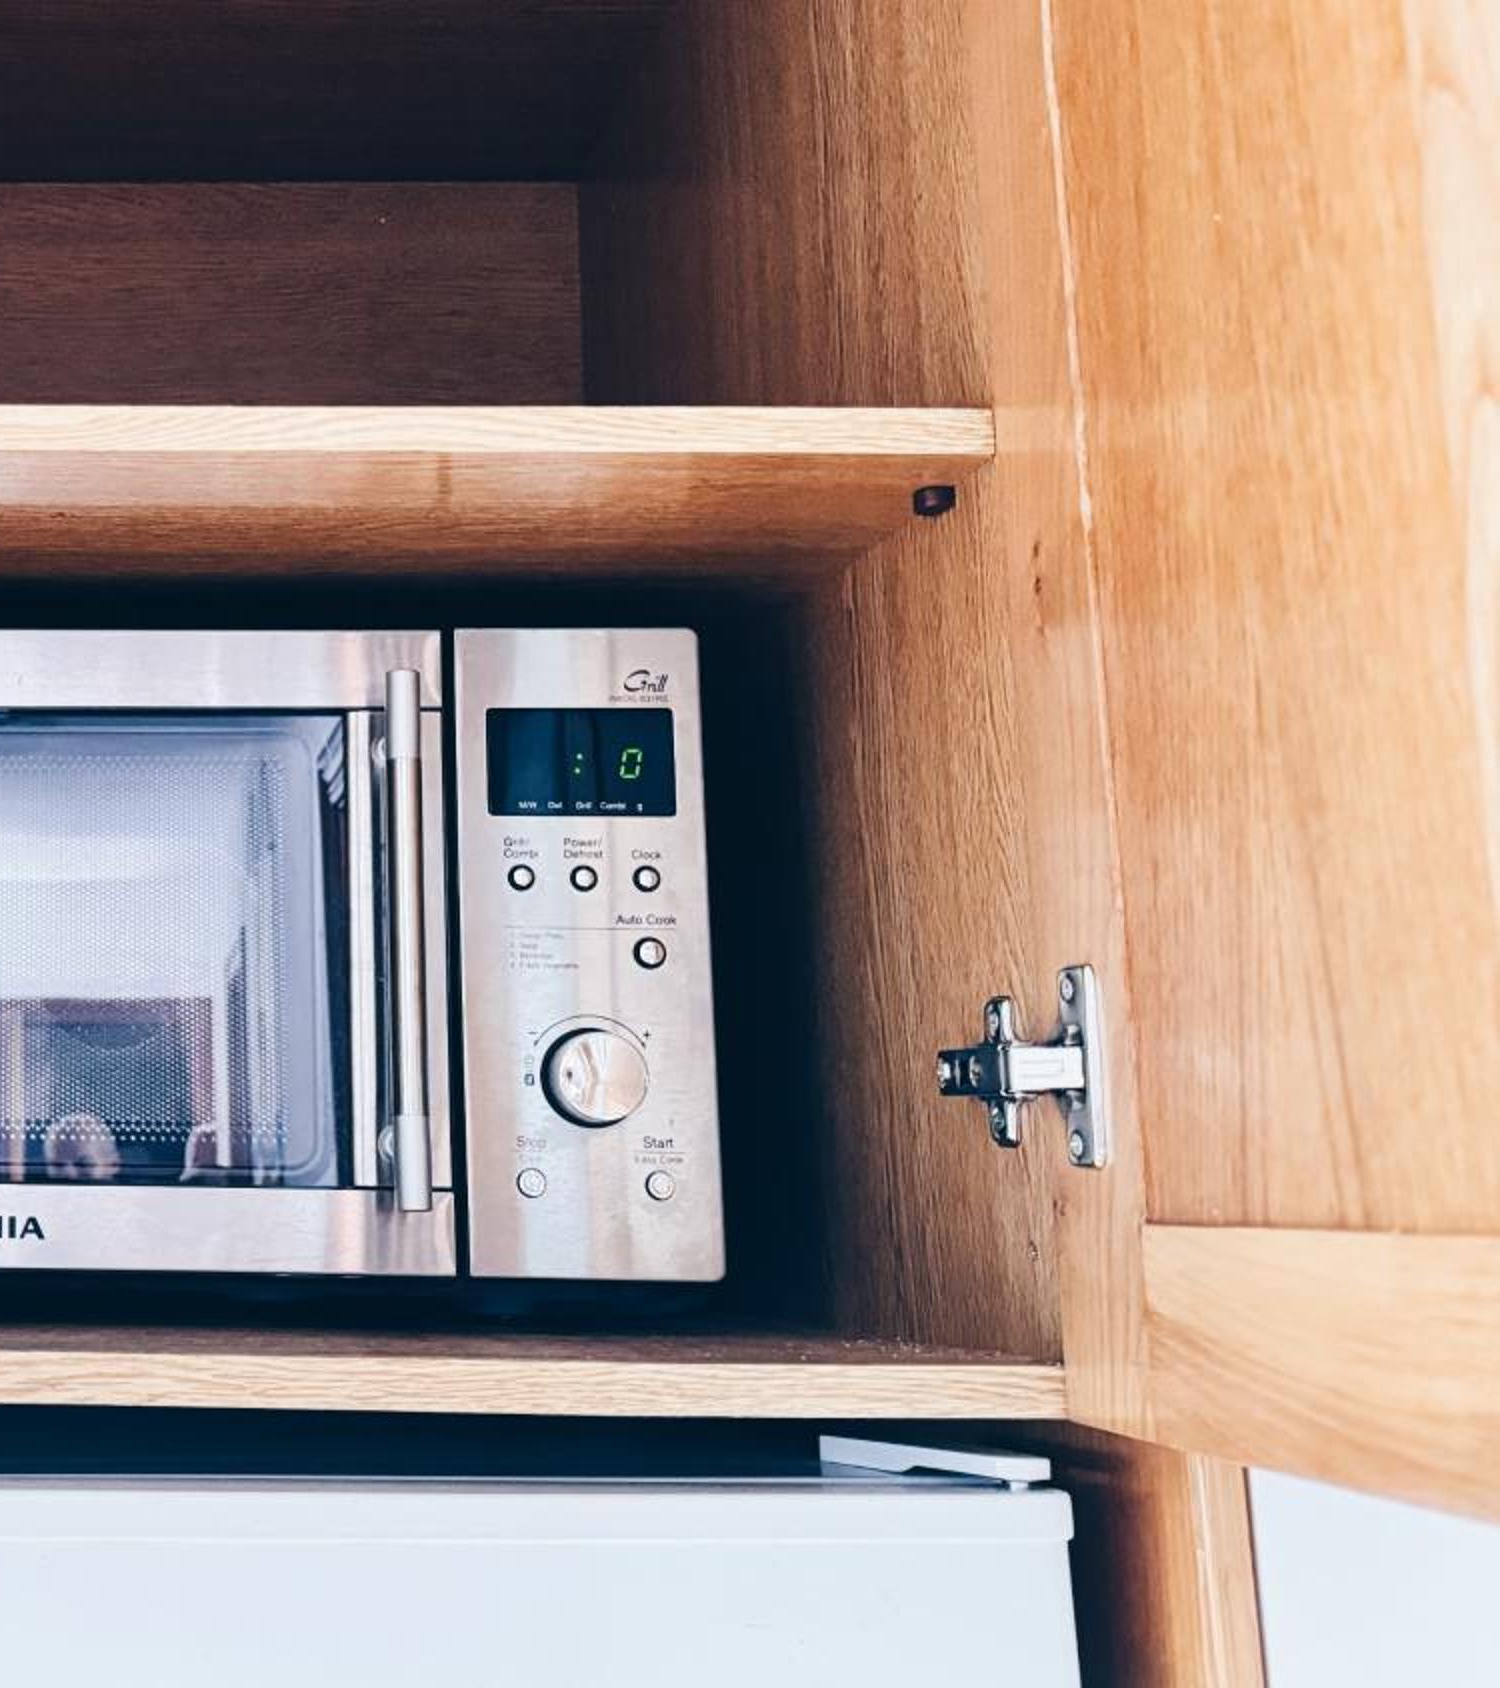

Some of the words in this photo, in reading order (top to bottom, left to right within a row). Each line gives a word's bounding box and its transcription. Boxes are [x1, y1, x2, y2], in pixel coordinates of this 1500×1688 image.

[623, 669, 668, 692] Grill
[631, 850, 661, 859] Clock
[615, 914, 643, 925] Auto
[645, 914, 677, 925] Cook
[643, 1136, 674, 1149] Start
